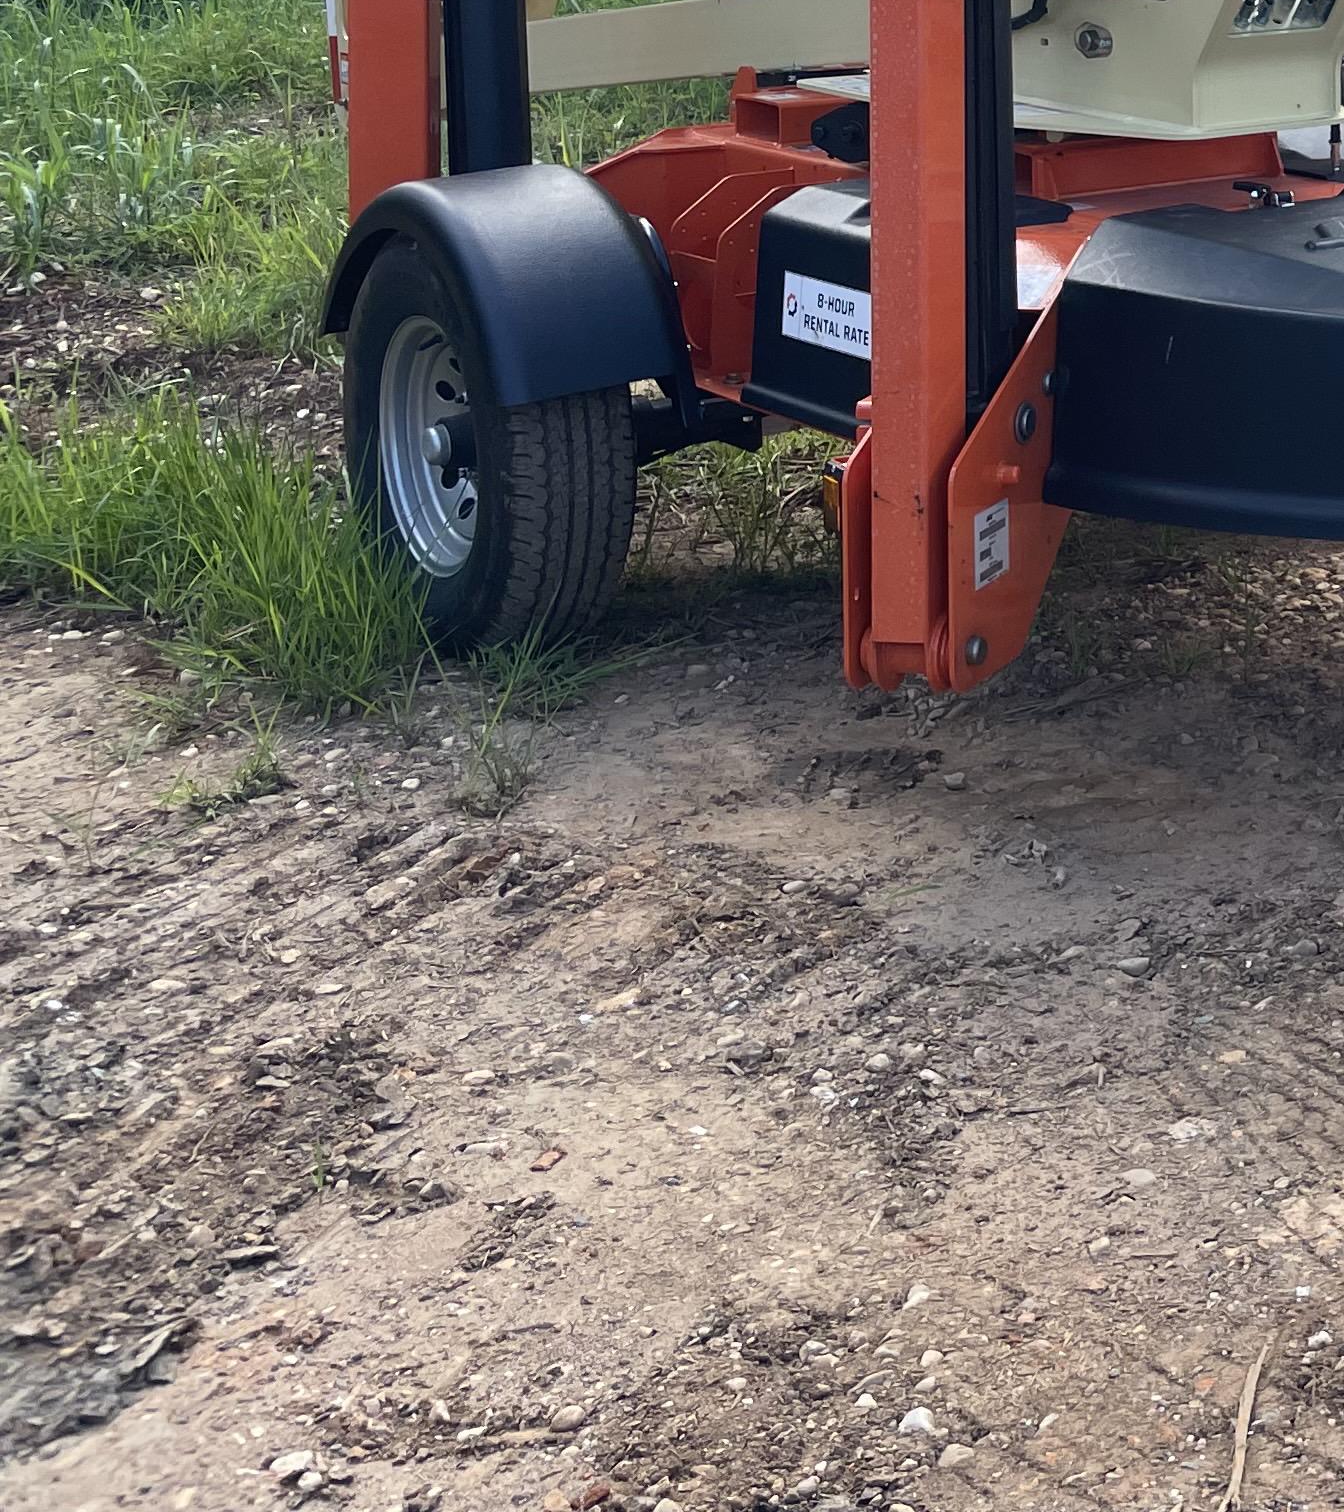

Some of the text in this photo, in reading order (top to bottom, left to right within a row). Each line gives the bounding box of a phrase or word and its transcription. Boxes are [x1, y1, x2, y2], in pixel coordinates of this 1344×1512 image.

[817, 293, 855, 317] 8-HOUR
[803, 313, 870, 346] RENTAL RATE
